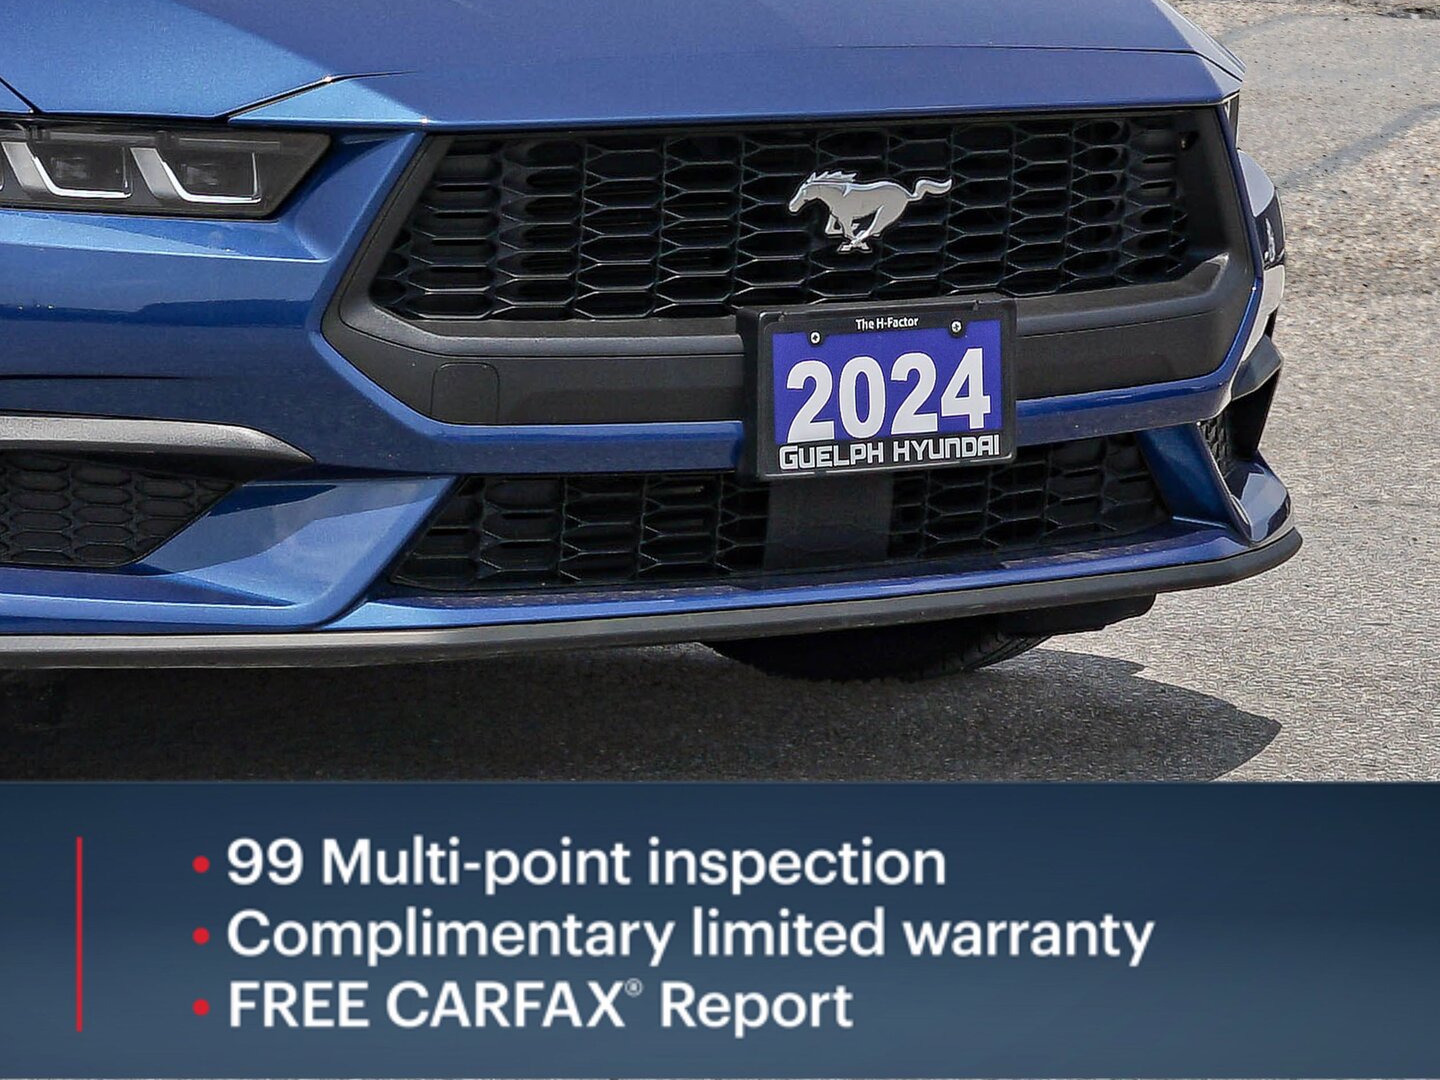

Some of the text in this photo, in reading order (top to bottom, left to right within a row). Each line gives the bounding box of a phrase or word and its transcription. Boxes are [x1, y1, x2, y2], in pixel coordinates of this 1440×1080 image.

[856, 316, 919, 331] The H-Factor
[786, 347, 991, 444] 2024
[779, 434, 1000, 471] GUELPH HYUNDAI
